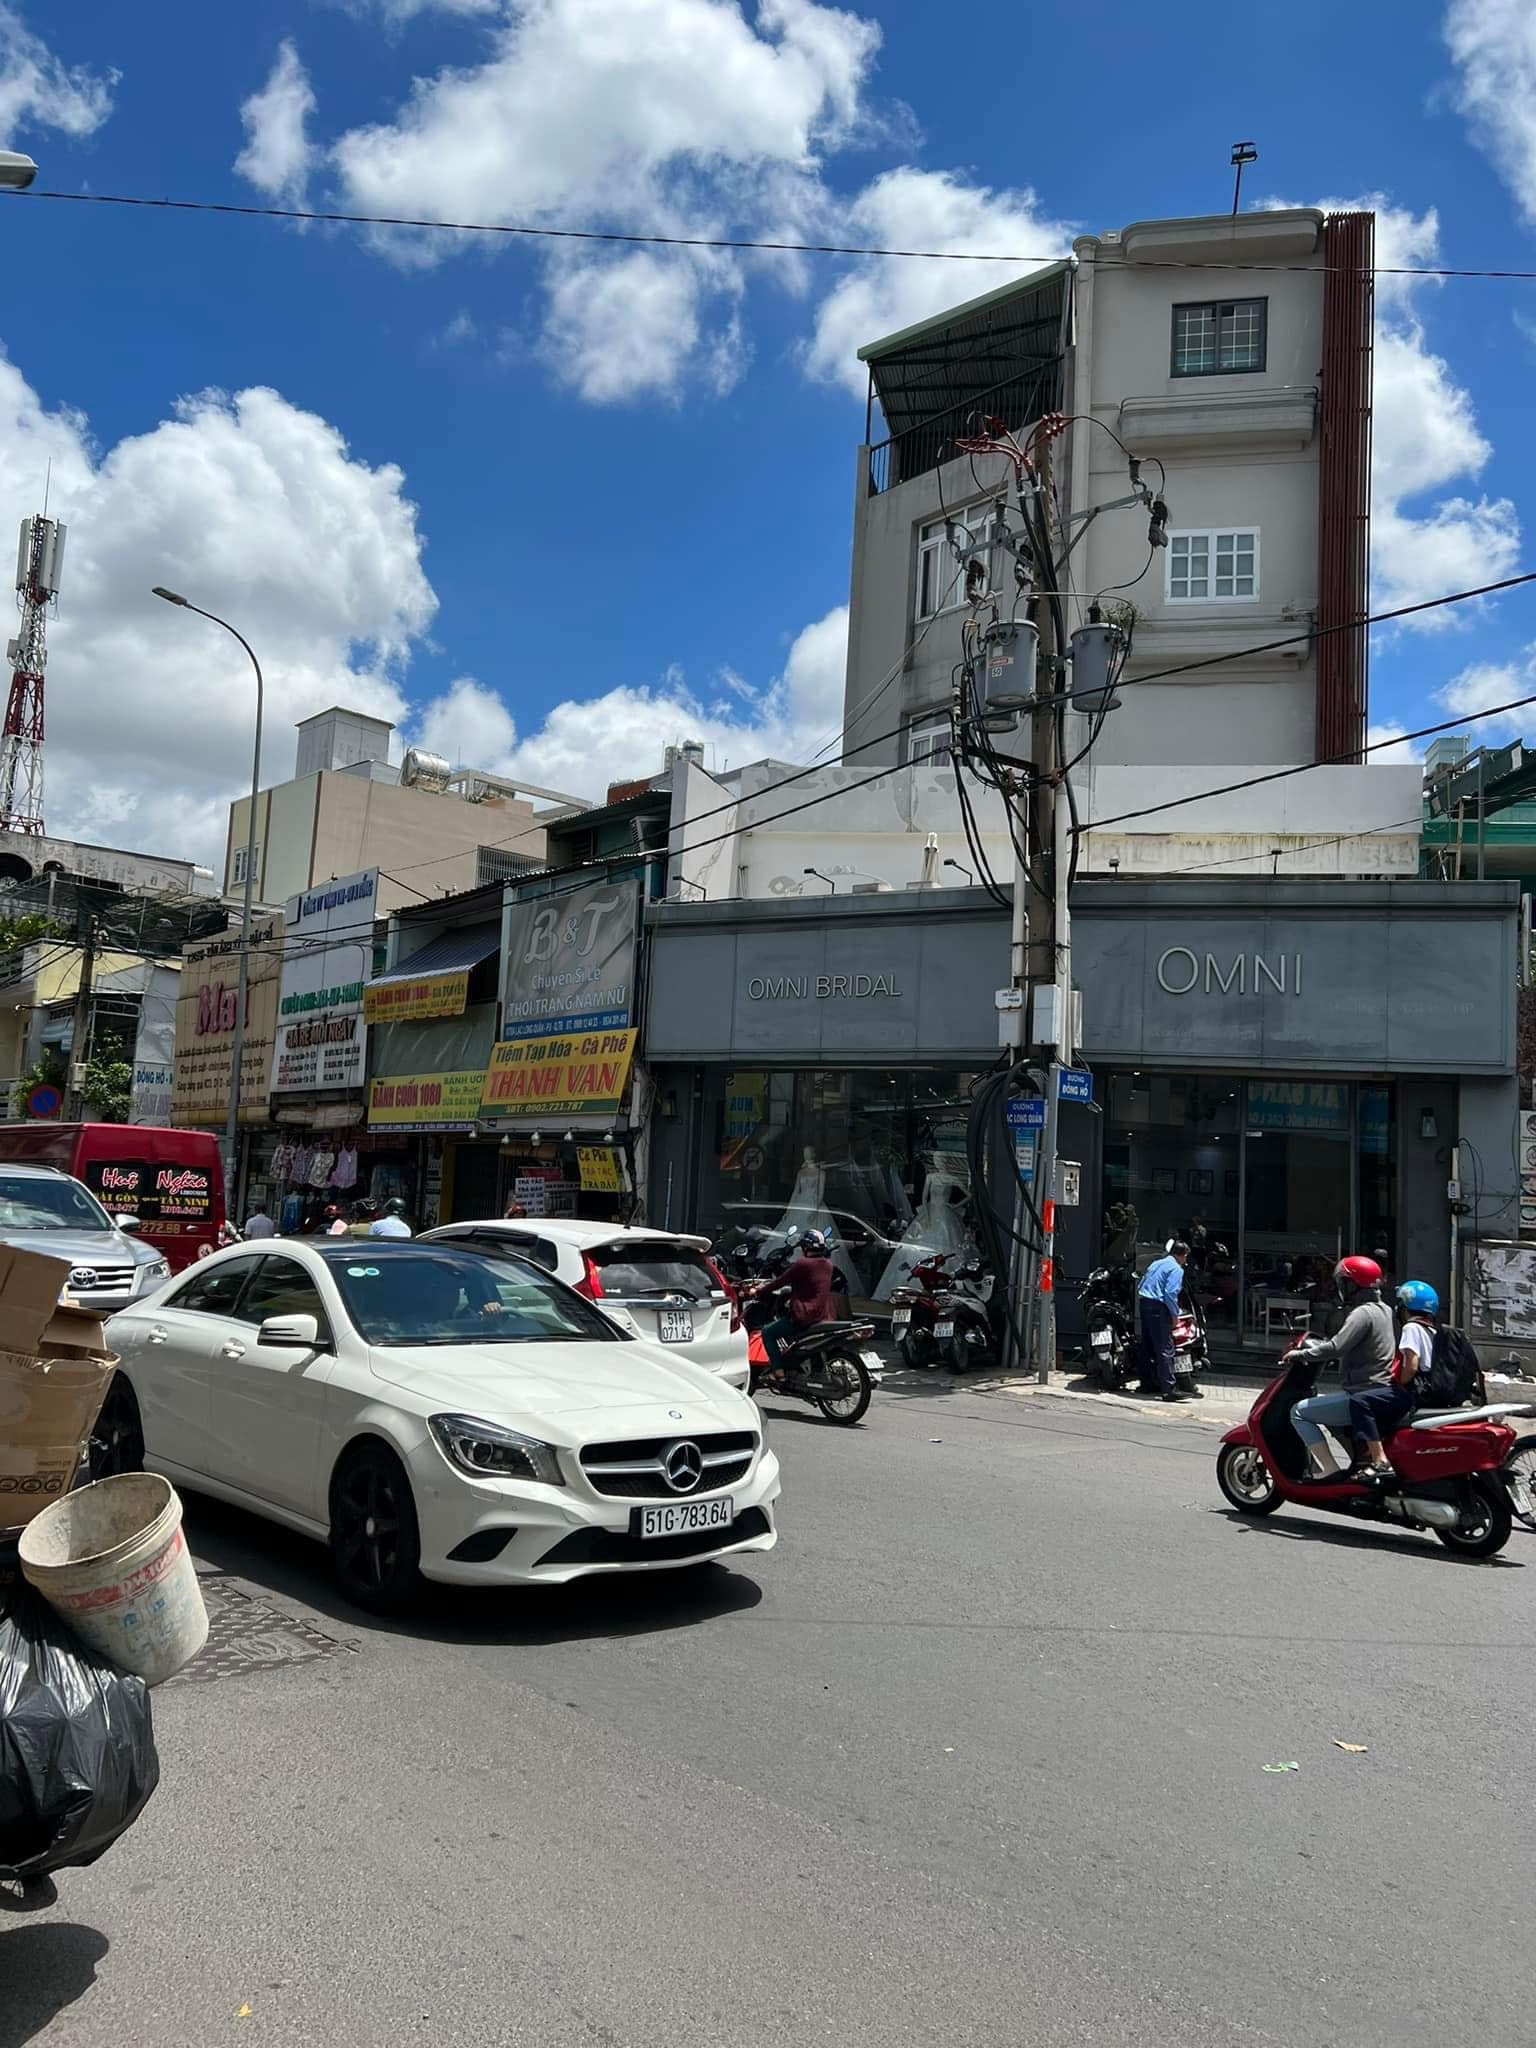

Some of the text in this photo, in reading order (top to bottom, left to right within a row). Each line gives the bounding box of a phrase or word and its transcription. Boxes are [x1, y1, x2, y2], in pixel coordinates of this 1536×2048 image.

[1157, 946, 1303, 996] OMNI
[749, 975, 902, 1000] OMNI BRIDAL
[535, 995, 573, 1013] TRANG
[575, 990, 604, 1008] NAM
[496, 1044, 523, 1066] Tiệm
[525, 1043, 545, 1064] Tạp
[547, 1039, 572, 1059] Hóa
[601, 1033, 628, 1053] Phê
[420, 1082, 442, 1107] 1080
[488, 1066, 564, 1098] THANH
[1014, 1113, 1028, 1124] LONG
[155, 1169, 208, 1196] Nghĩa
[96, 1192, 112, 1202] ÀI
[184, 1197, 209, 1207] NINH
[667, 1312, 685, 1326] 51H
[645, 1501, 728, 1535] 51G-783.64
